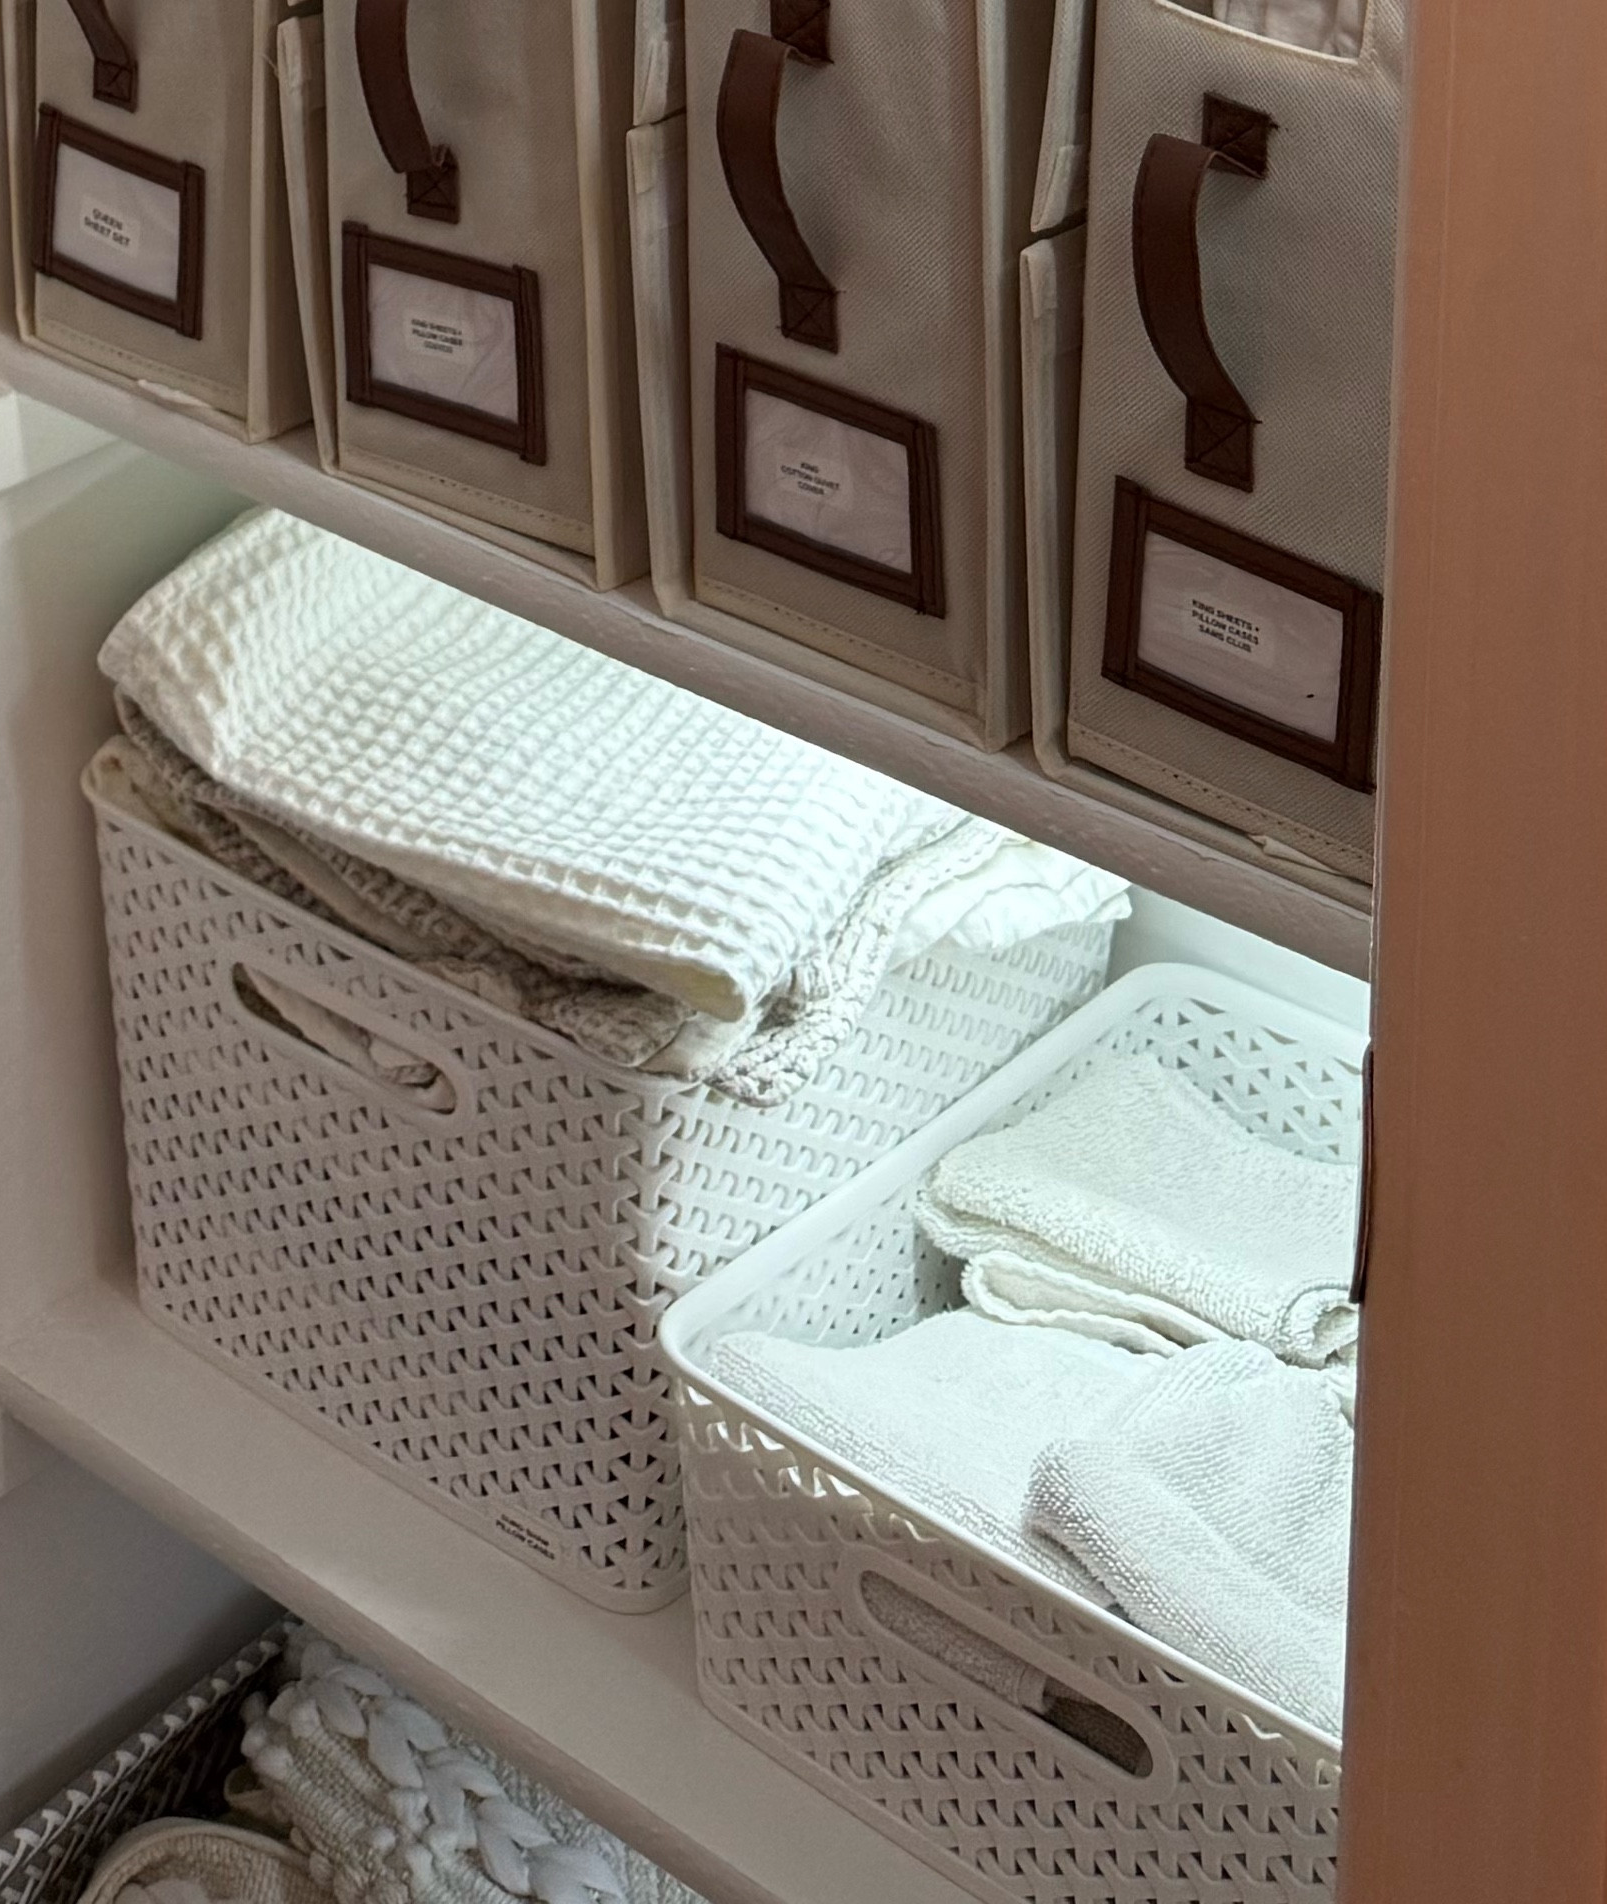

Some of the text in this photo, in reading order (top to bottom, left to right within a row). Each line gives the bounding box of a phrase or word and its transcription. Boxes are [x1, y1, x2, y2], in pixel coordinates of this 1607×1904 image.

[1192, 599, 1252, 631] KING SHEETS
[1192, 609, 1259, 645] PILLOW CASES
[1199, 624, 1252, 653] SAMS CLUB
[496, 1519, 555, 1561] PILLOW CASES
